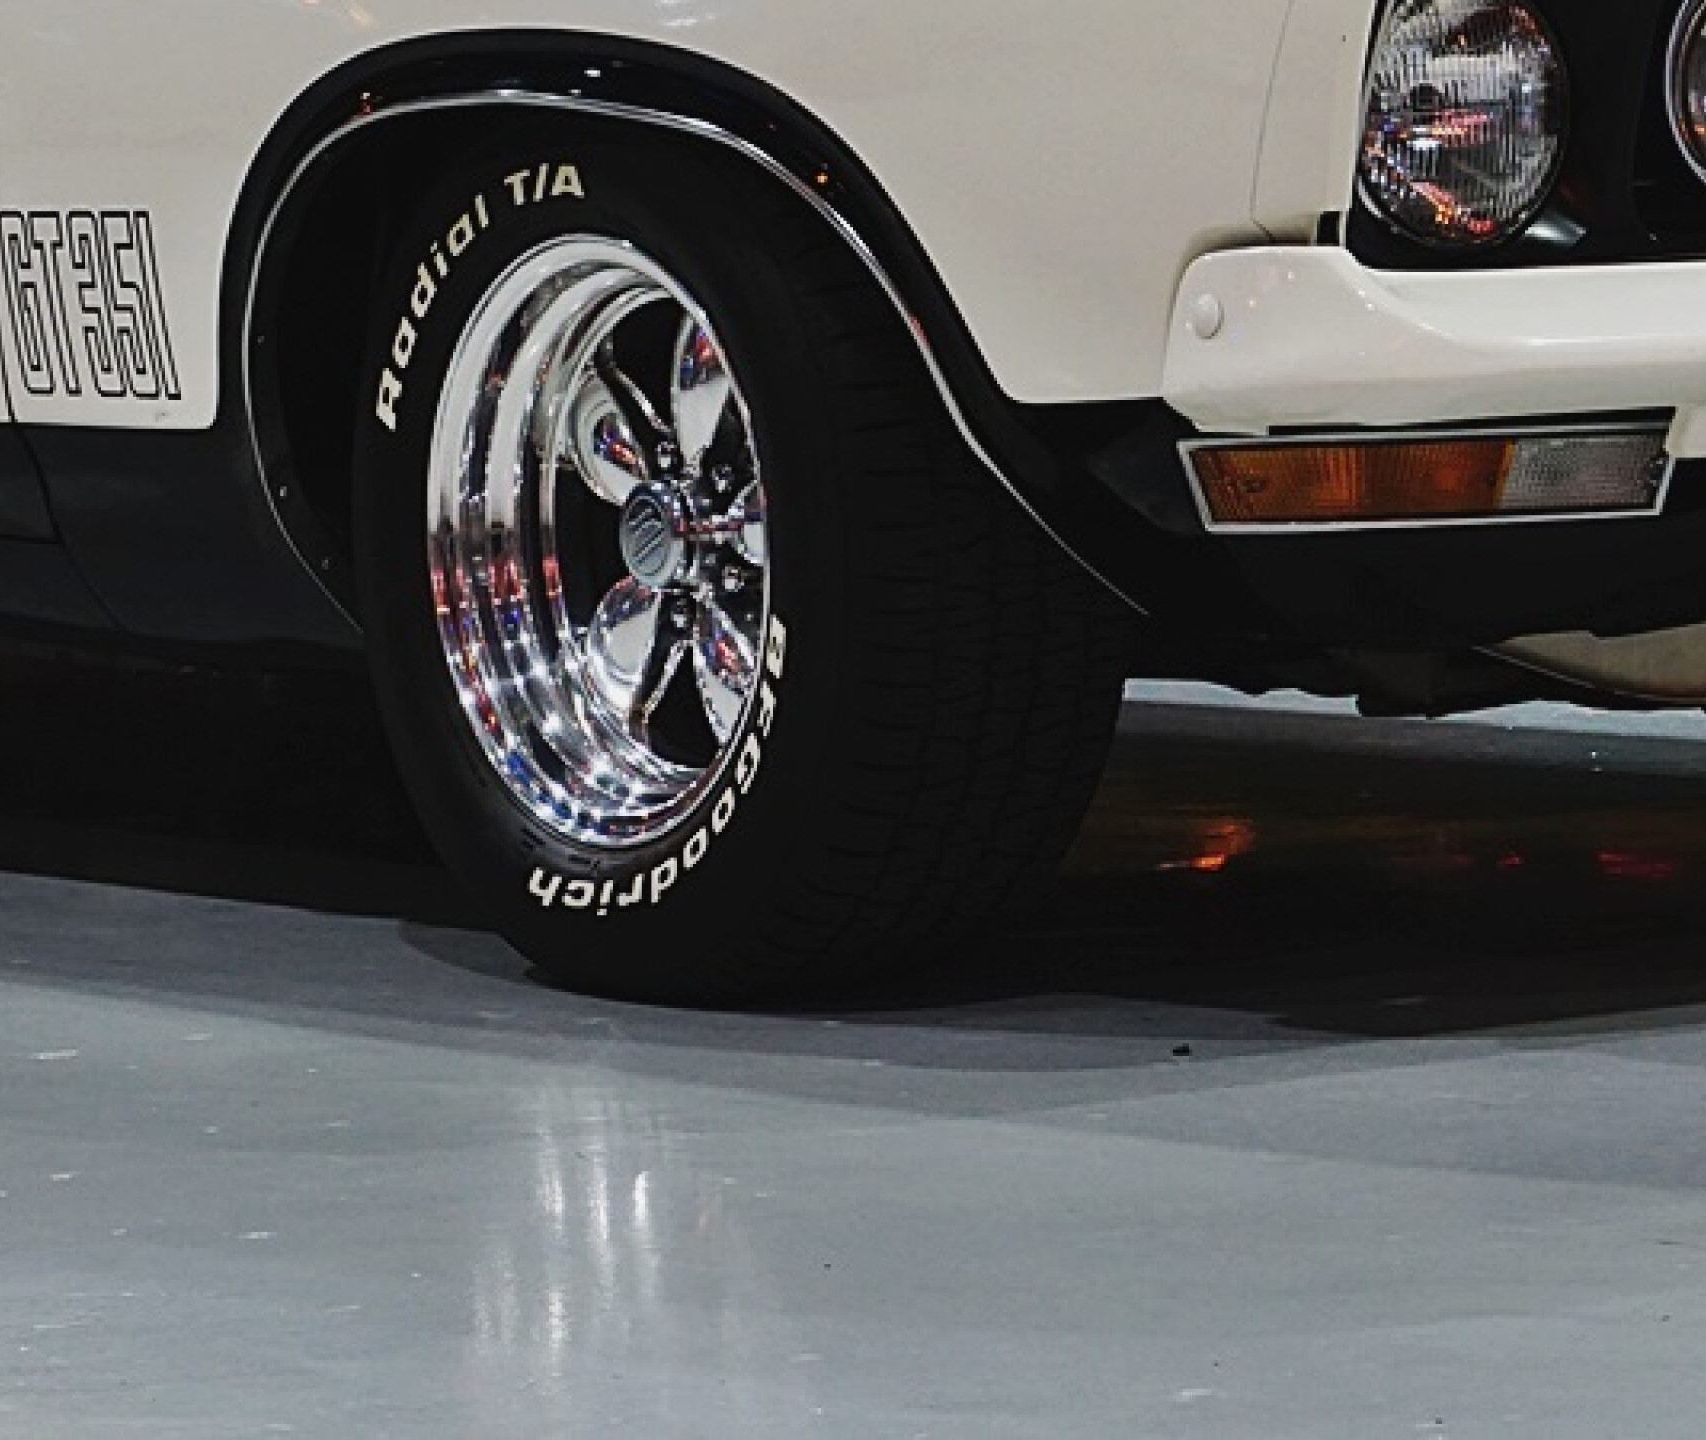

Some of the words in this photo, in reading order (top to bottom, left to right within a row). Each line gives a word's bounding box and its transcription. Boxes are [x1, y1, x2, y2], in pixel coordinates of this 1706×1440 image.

[373, 194, 490, 433] Radial
[503, 163, 585, 208] T/A
[528, 613, 786, 916] BFGoodrich
